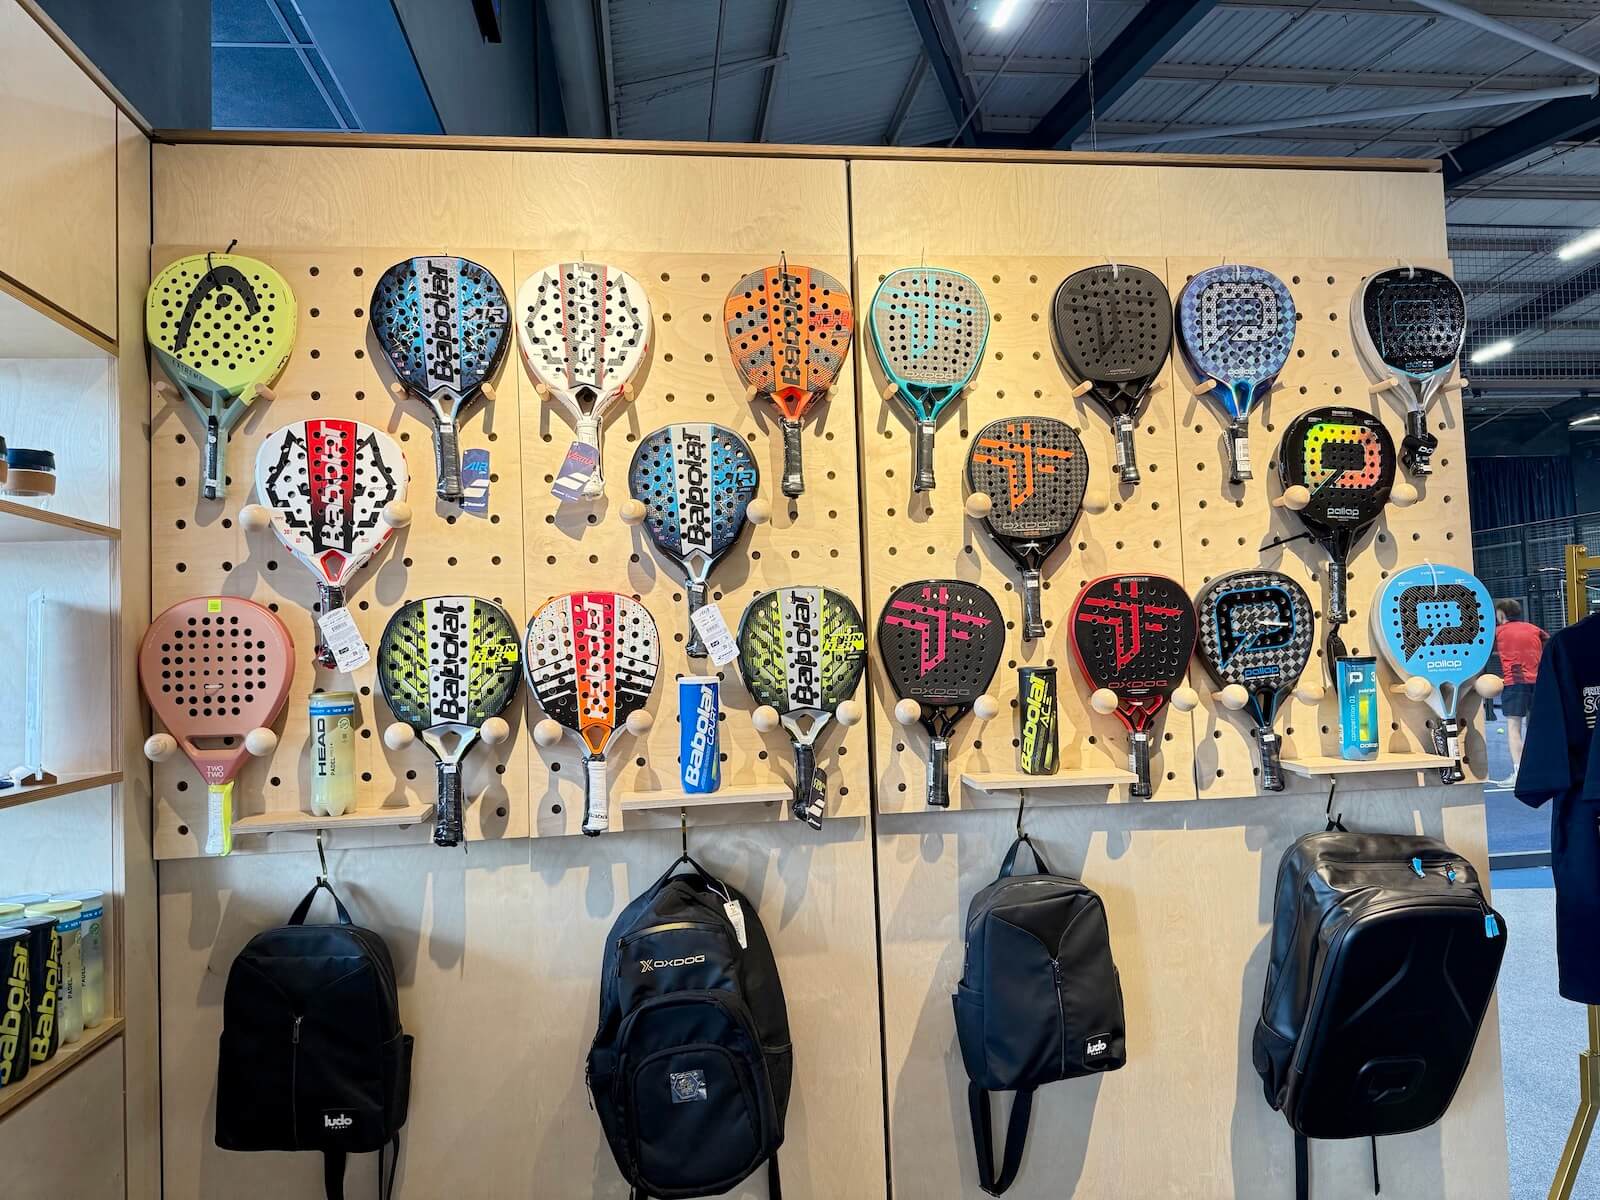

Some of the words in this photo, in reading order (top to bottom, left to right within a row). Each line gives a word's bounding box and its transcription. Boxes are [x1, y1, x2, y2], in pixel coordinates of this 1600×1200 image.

[1002, 520, 1059, 529] OXDOG
[1108, 679, 1169, 689] OXDOG
[910, 687, 970, 695] OXDOG
[317, 718, 327, 776] HEAD
[653, 954, 706, 968] OXDOG
[324, 1113, 353, 1128] ludo
